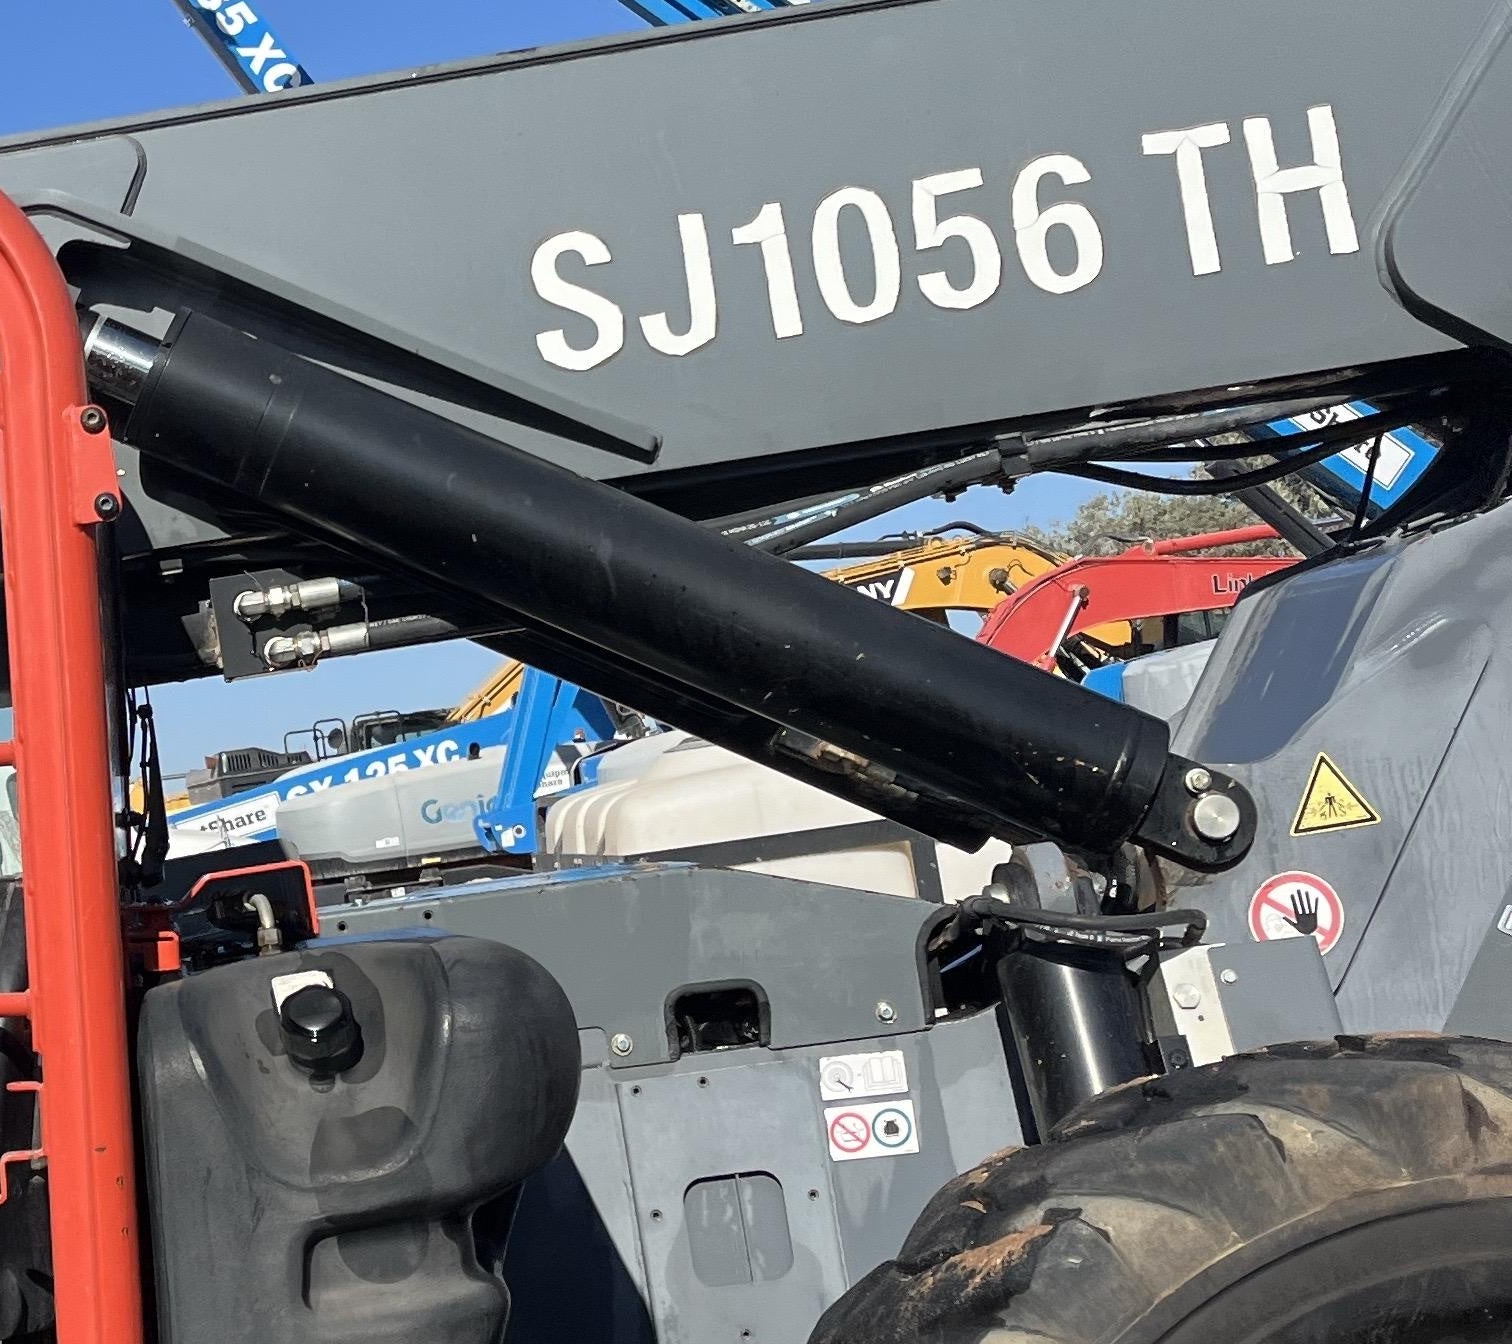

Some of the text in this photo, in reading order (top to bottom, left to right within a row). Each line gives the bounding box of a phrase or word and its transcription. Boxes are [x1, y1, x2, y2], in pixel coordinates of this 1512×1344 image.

[235, 31, 302, 93] XC
[529, 103, 1360, 372] SJ1056 TH
